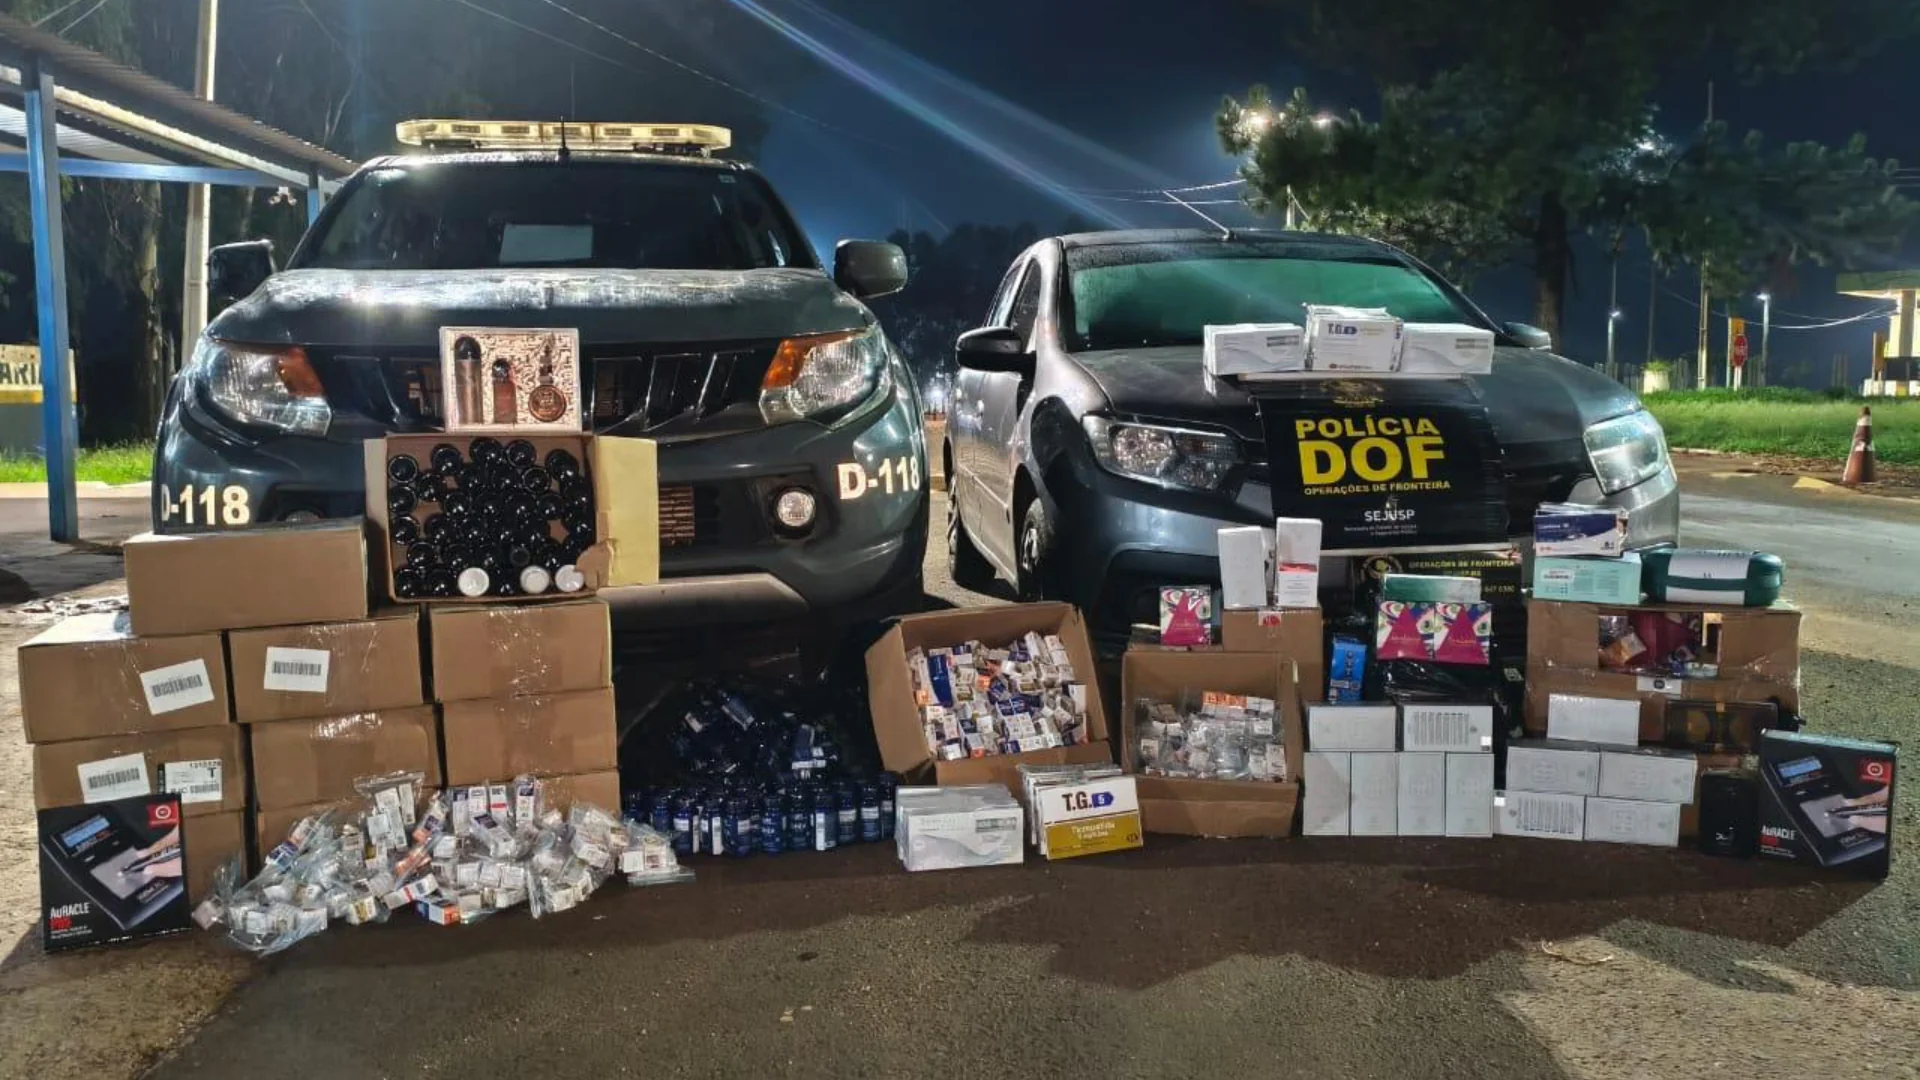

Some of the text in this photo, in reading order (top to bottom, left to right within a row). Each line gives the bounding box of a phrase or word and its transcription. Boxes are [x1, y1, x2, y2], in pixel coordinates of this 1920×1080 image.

[1295, 414, 1440, 439] POLÍCIA
[1299, 436, 1445, 485] DOF
[838, 456, 920, 499] D-118
[1304, 480, 1451, 496] OPERAÇÕES DE FRONTEIRA
[1364, 509, 1415, 522] SEJUSP
